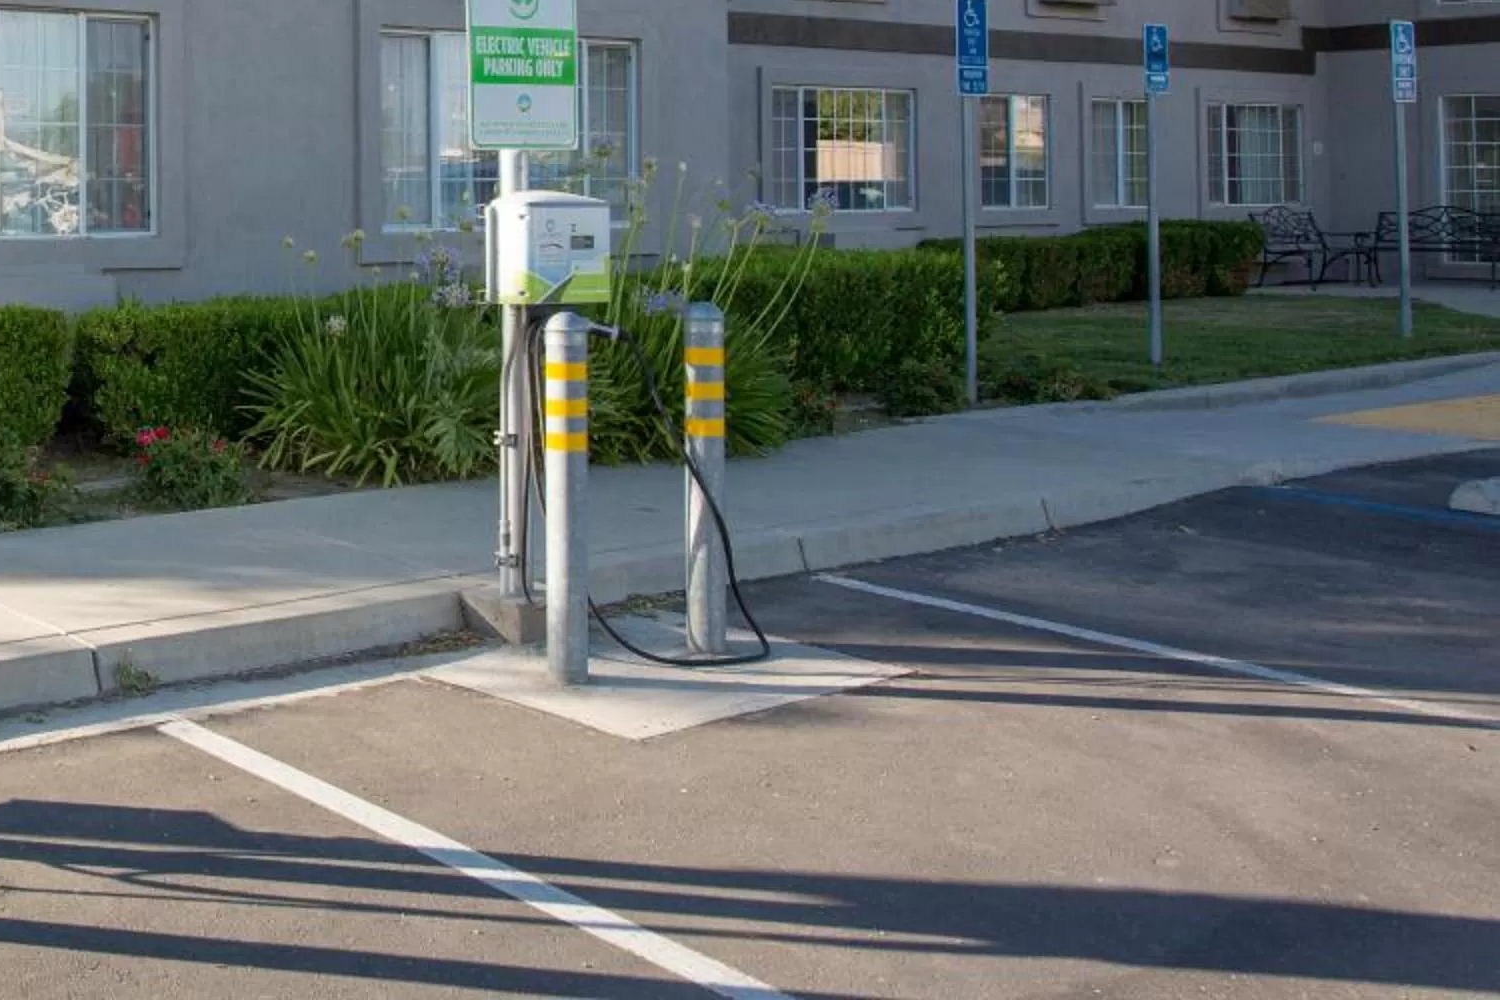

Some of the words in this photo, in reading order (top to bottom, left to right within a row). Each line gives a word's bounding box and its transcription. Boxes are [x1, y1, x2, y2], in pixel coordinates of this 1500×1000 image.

[475, 35, 525, 56] ELECTRIC
[527, 36, 571, 57] VEHICLE
[483, 58, 533, 77] PARKING
[535, 59, 564, 78] ONLY
